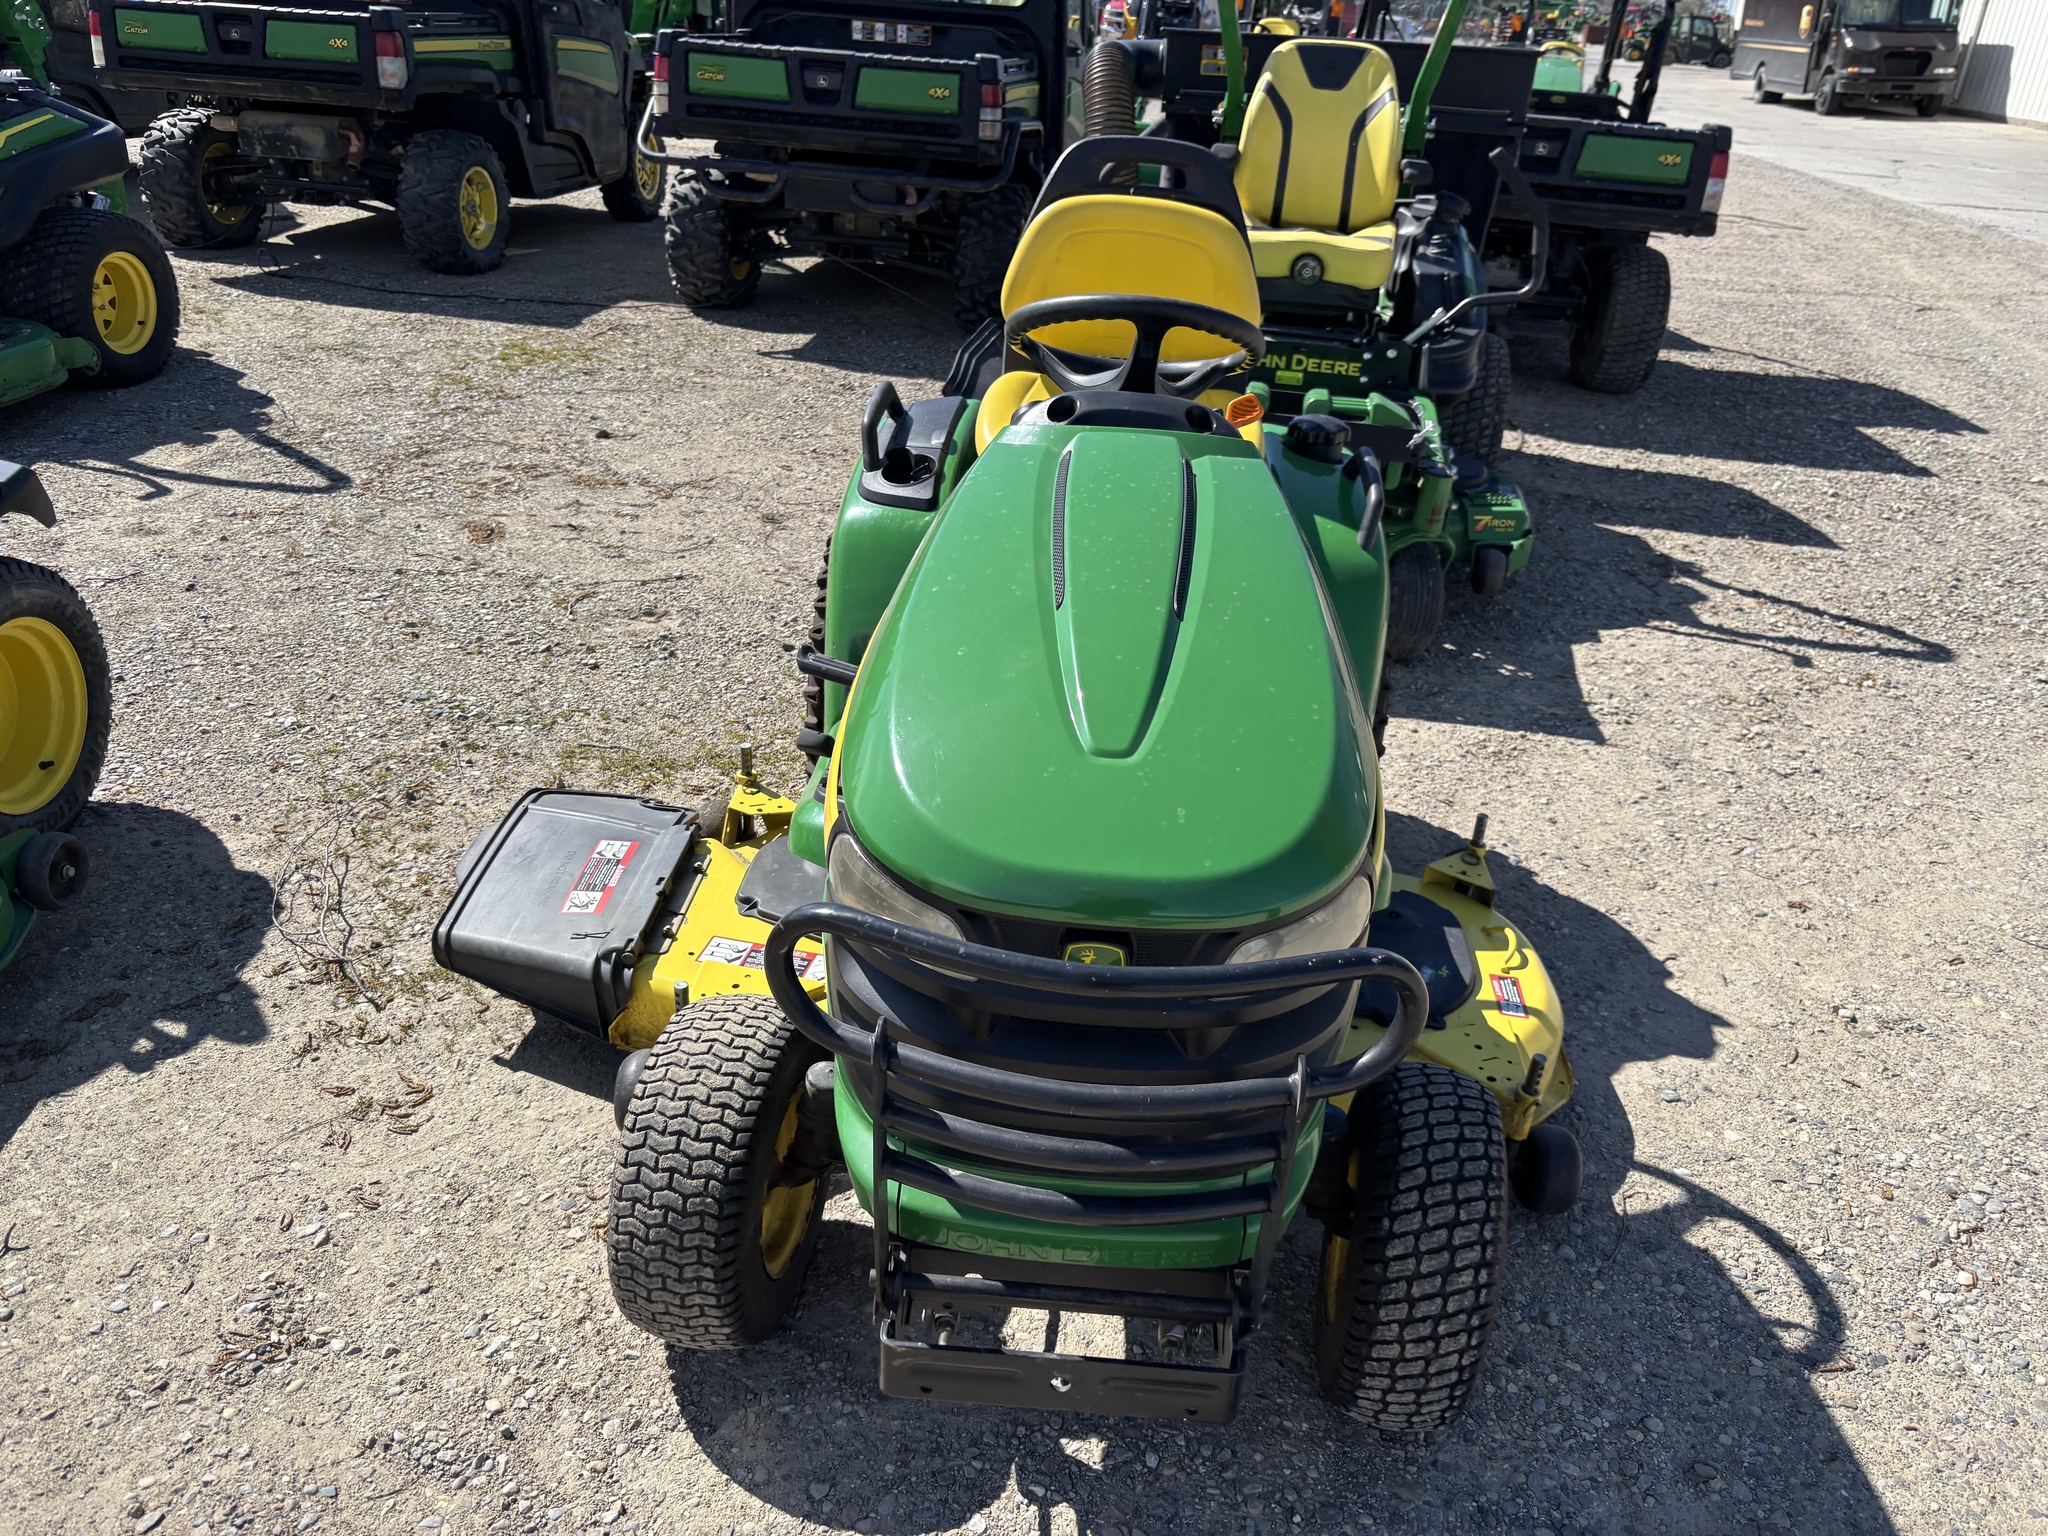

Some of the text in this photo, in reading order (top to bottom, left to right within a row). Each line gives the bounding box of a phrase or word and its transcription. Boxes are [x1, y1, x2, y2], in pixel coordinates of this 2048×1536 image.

[124, 25, 149, 34] GATOR
[328, 37, 349, 49] 4X4
[928, 87, 951, 99] 4X4
[1657, 154, 1681, 166] 4X4
[1290, 353, 1363, 377] DEERE
[1473, 515, 1493, 532] 7
[565, 851, 577, 861] DO
[934, 1227, 1215, 1268] JOHN DEERE
